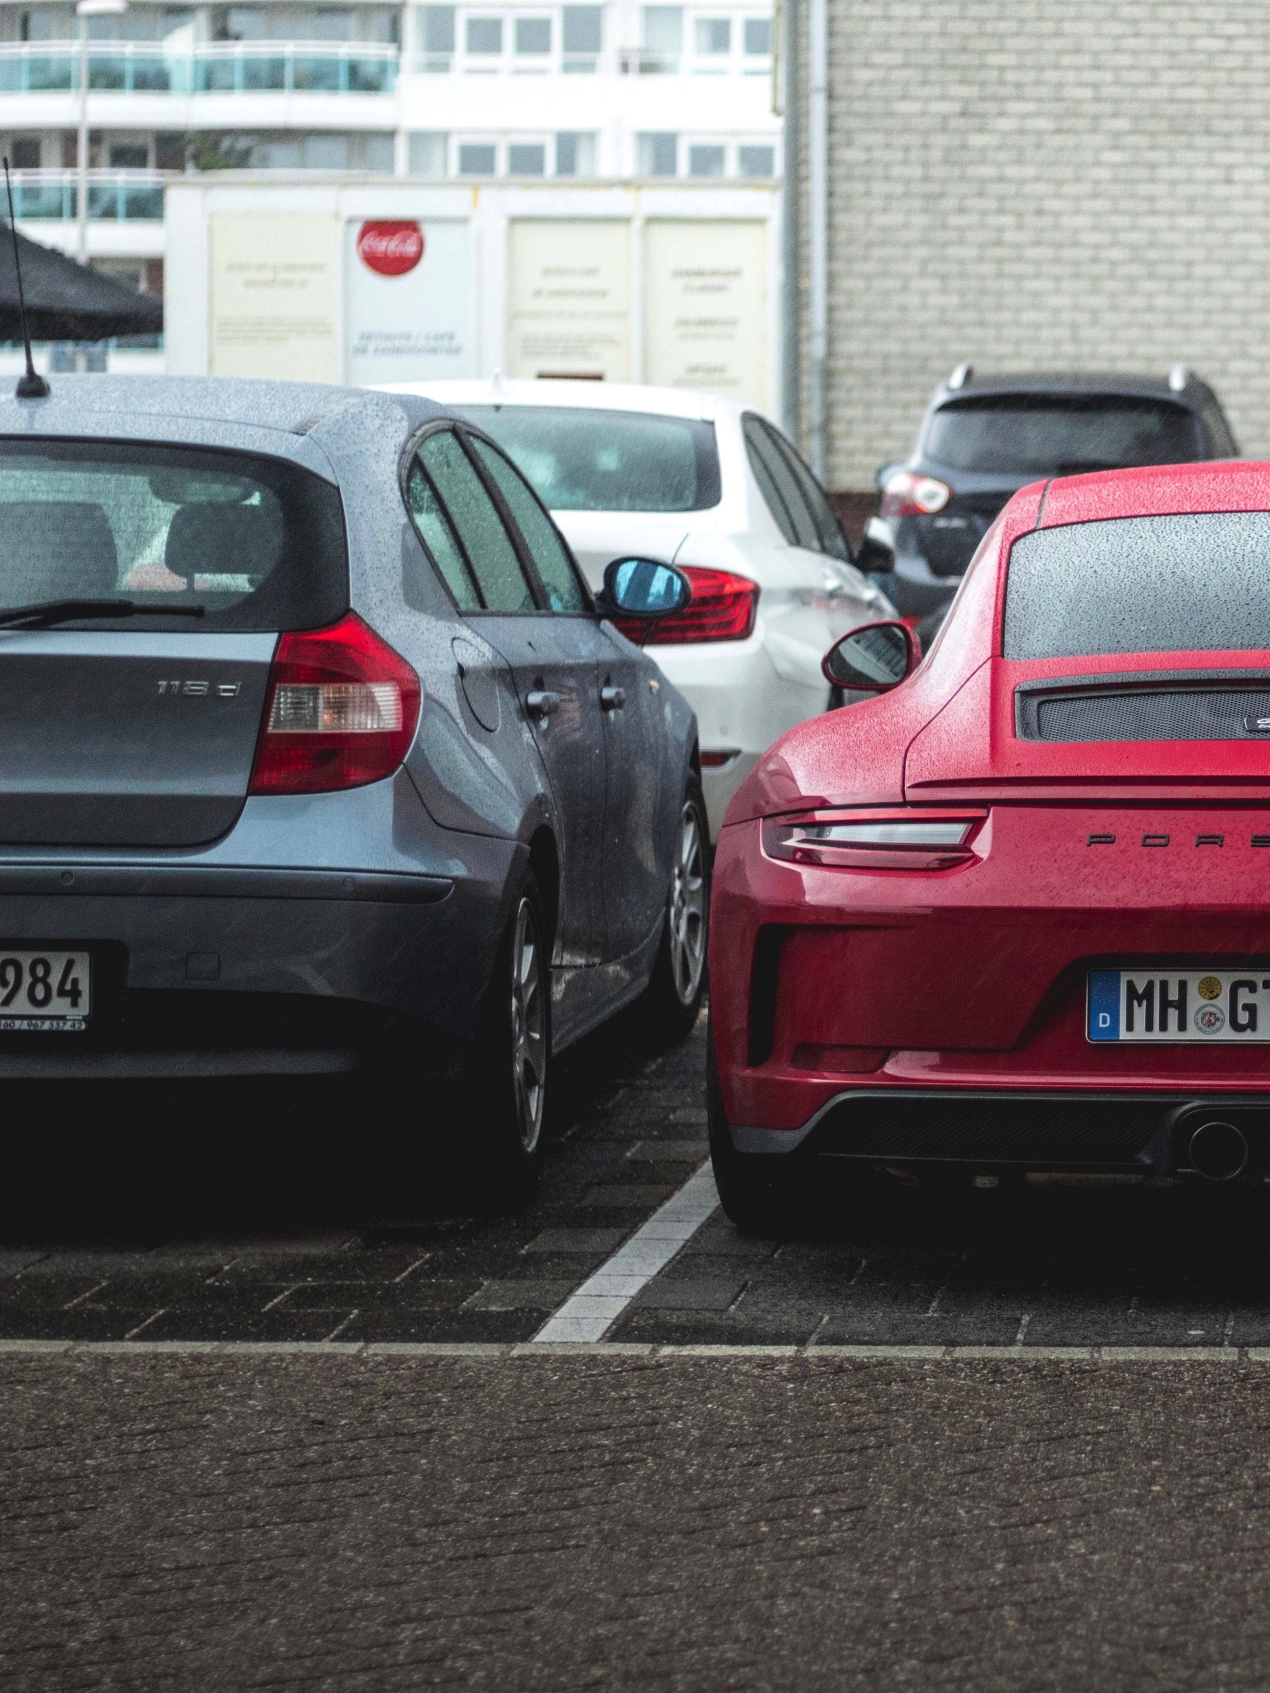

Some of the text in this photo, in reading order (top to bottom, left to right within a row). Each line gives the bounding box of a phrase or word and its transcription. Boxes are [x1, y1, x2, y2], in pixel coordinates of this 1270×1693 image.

[0, 957, 82, 1008] 984
[1126, 979, 1188, 1032] MH
[1099, 1013, 1110, 1027] D
